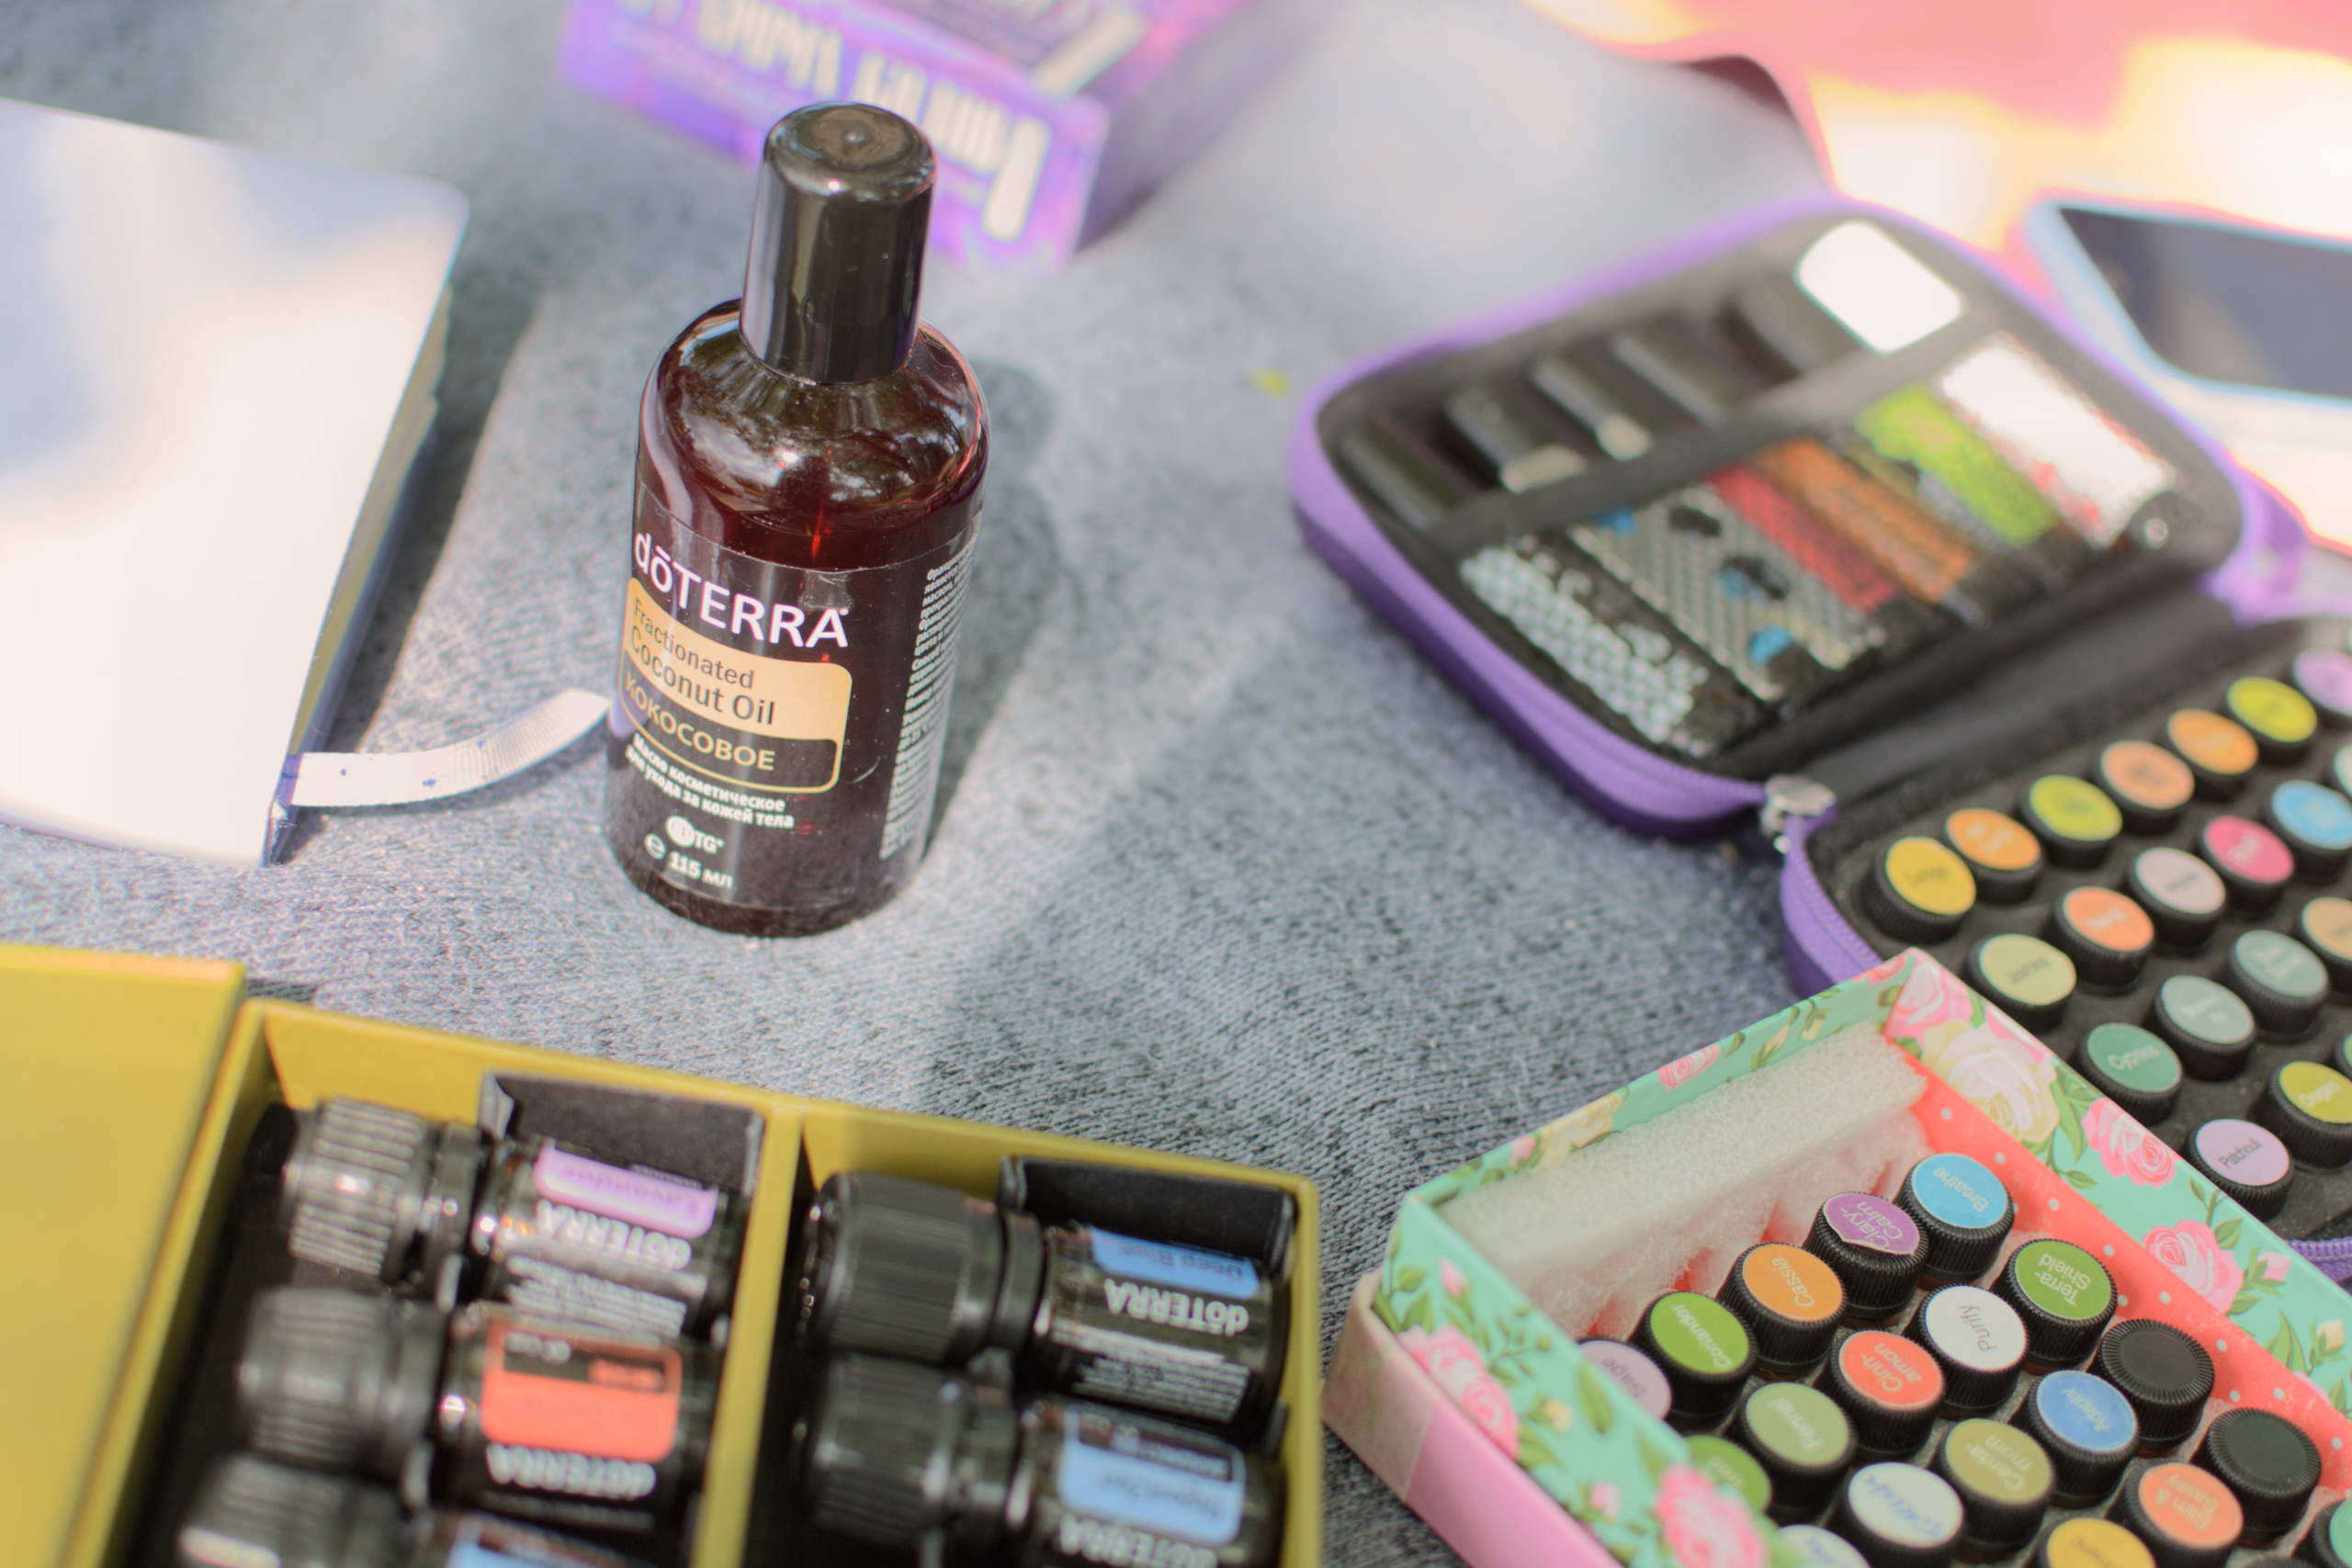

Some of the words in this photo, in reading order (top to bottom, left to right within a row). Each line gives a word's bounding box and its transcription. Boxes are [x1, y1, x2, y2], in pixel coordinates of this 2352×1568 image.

[634, 597, 754, 689] Fractionated
[631, 625, 723, 713] Coconut
[732, 694, 775, 725] Oil
[626, 672, 775, 772] КОКОСОВОЕ
[632, 732, 669, 774] Масло
[669, 765, 786, 812] косметическое
[644, 764, 683, 799] ухода
[682, 790, 701, 808] за
[701, 797, 753, 825] кожей
[755, 811, 795, 829] тела
[669, 850, 702, 879] 115
[701, 868, 734, 889] мл
[2218, 1137, 2263, 1170] Patchouli
[1933, 1166, 1990, 1213] Breathe
[1856, 1200, 1903, 1240] Calm
[1118, 1243, 1175, 1270] Blue
[1180, 1253, 1244, 1281] Deep
[2037, 1253, 2091, 1291] Shield
[1771, 1256, 1815, 1308] Cassia
[2034, 1271, 2078, 1306] Terra-
[1670, 1303, 1733, 1369] Coriander
[1958, 1303, 1999, 1353] Purify
[1601, 1355, 1648, 1399] Sage
[1860, 1352, 1903, 1393] Cinn-
[1873, 1341, 1923, 1383] amon
[1767, 1396, 1824, 1451] Fennel
[2062, 1386, 2112, 1433] Adaptiv
[2154, 1488, 2171, 1505] &
[2162, 1473, 2219, 1515] Sassy
[2171, 1499, 2212, 1531] Slim
